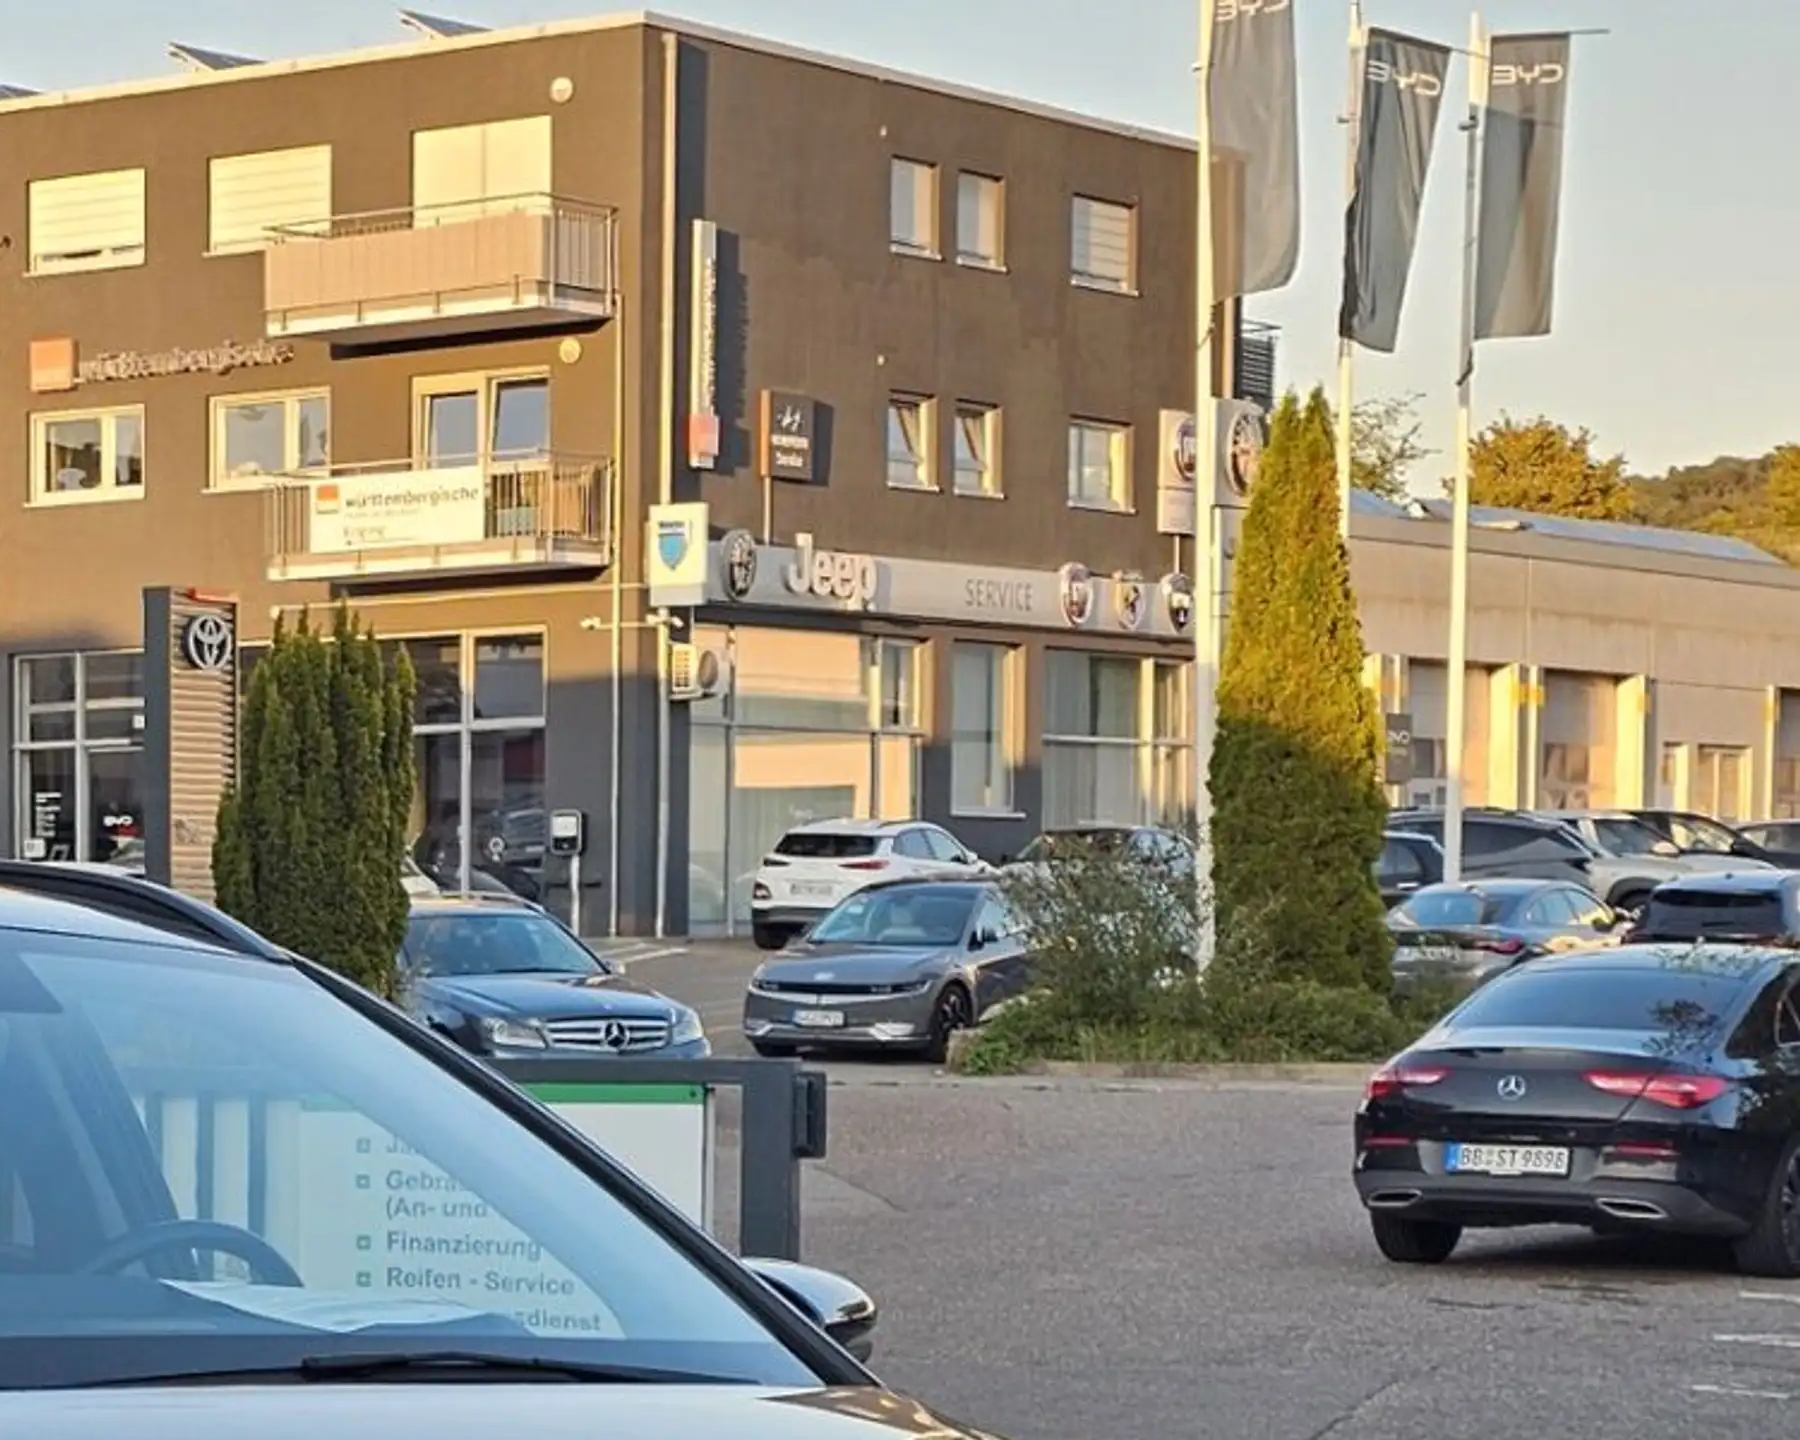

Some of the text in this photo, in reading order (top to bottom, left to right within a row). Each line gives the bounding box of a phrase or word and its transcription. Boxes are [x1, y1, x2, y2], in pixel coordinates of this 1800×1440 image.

[1367, 60, 1441, 96] BYD
[1491, 64, 1564, 86] BYD
[787, 532, 878, 612] Jeep
[964, 578, 1033, 612] SERVICE
[387, 1231, 542, 1262] Finanzierung
[387, 1267, 461, 1288] Reifen
[484, 1271, 575, 1296] Service
